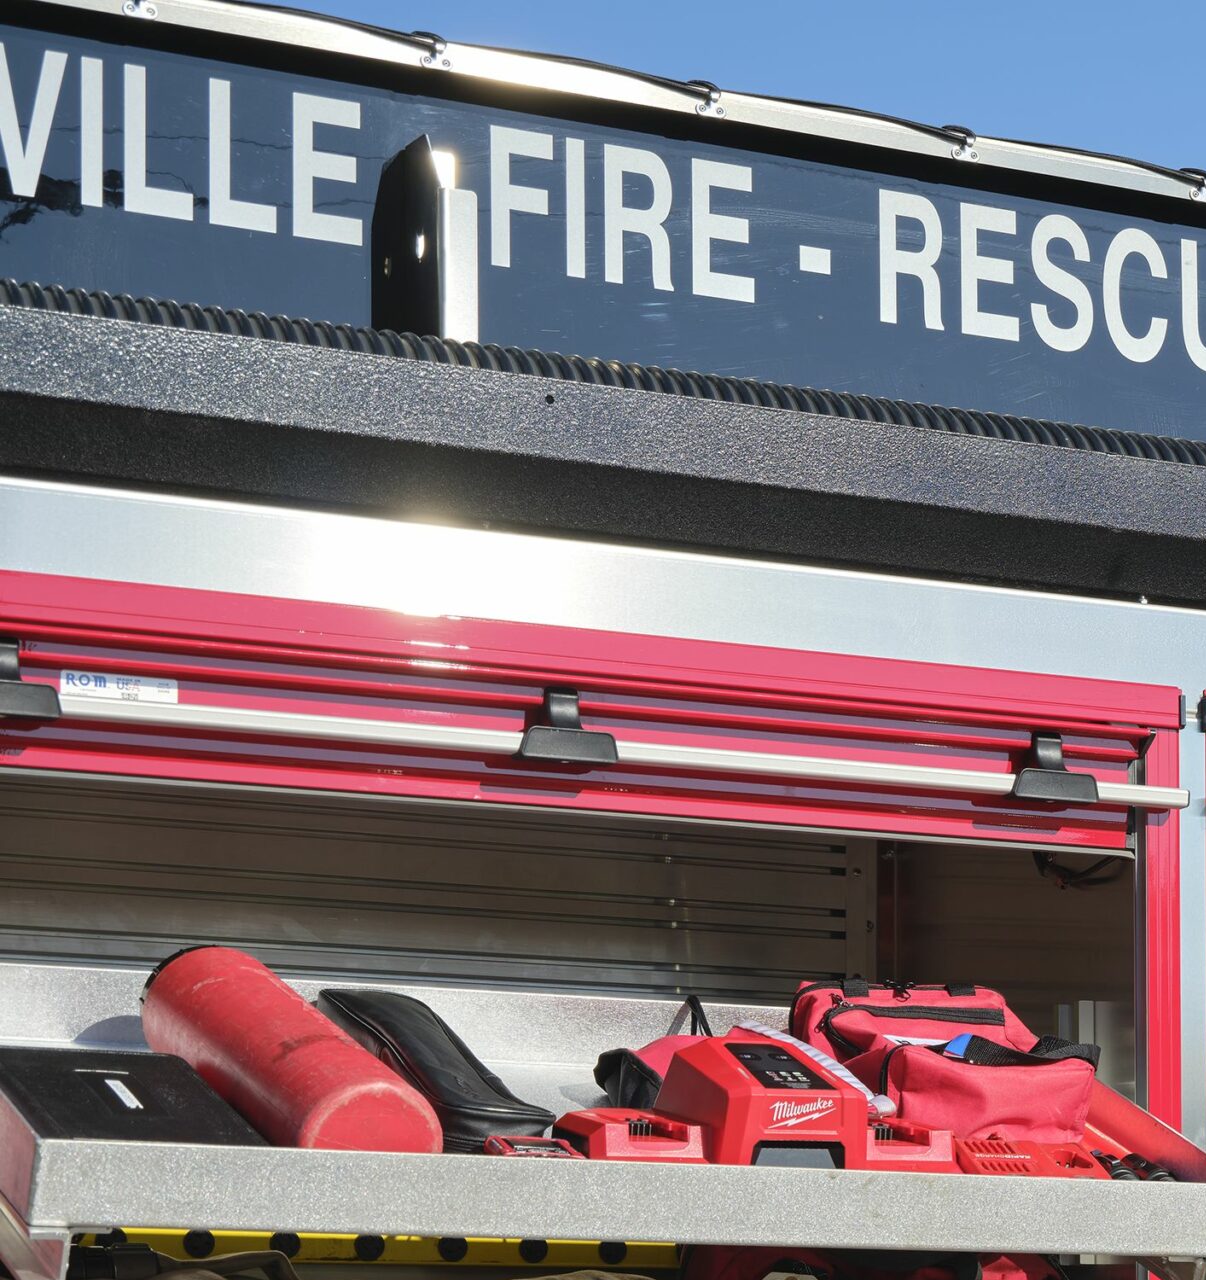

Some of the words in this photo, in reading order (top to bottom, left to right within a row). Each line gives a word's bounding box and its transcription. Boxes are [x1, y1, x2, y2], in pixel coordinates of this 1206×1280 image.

[0, 42, 363, 246] VILLE
[490, 125, 756, 304] FIRE
[769, 1097, 834, 1122] Milwaukee
